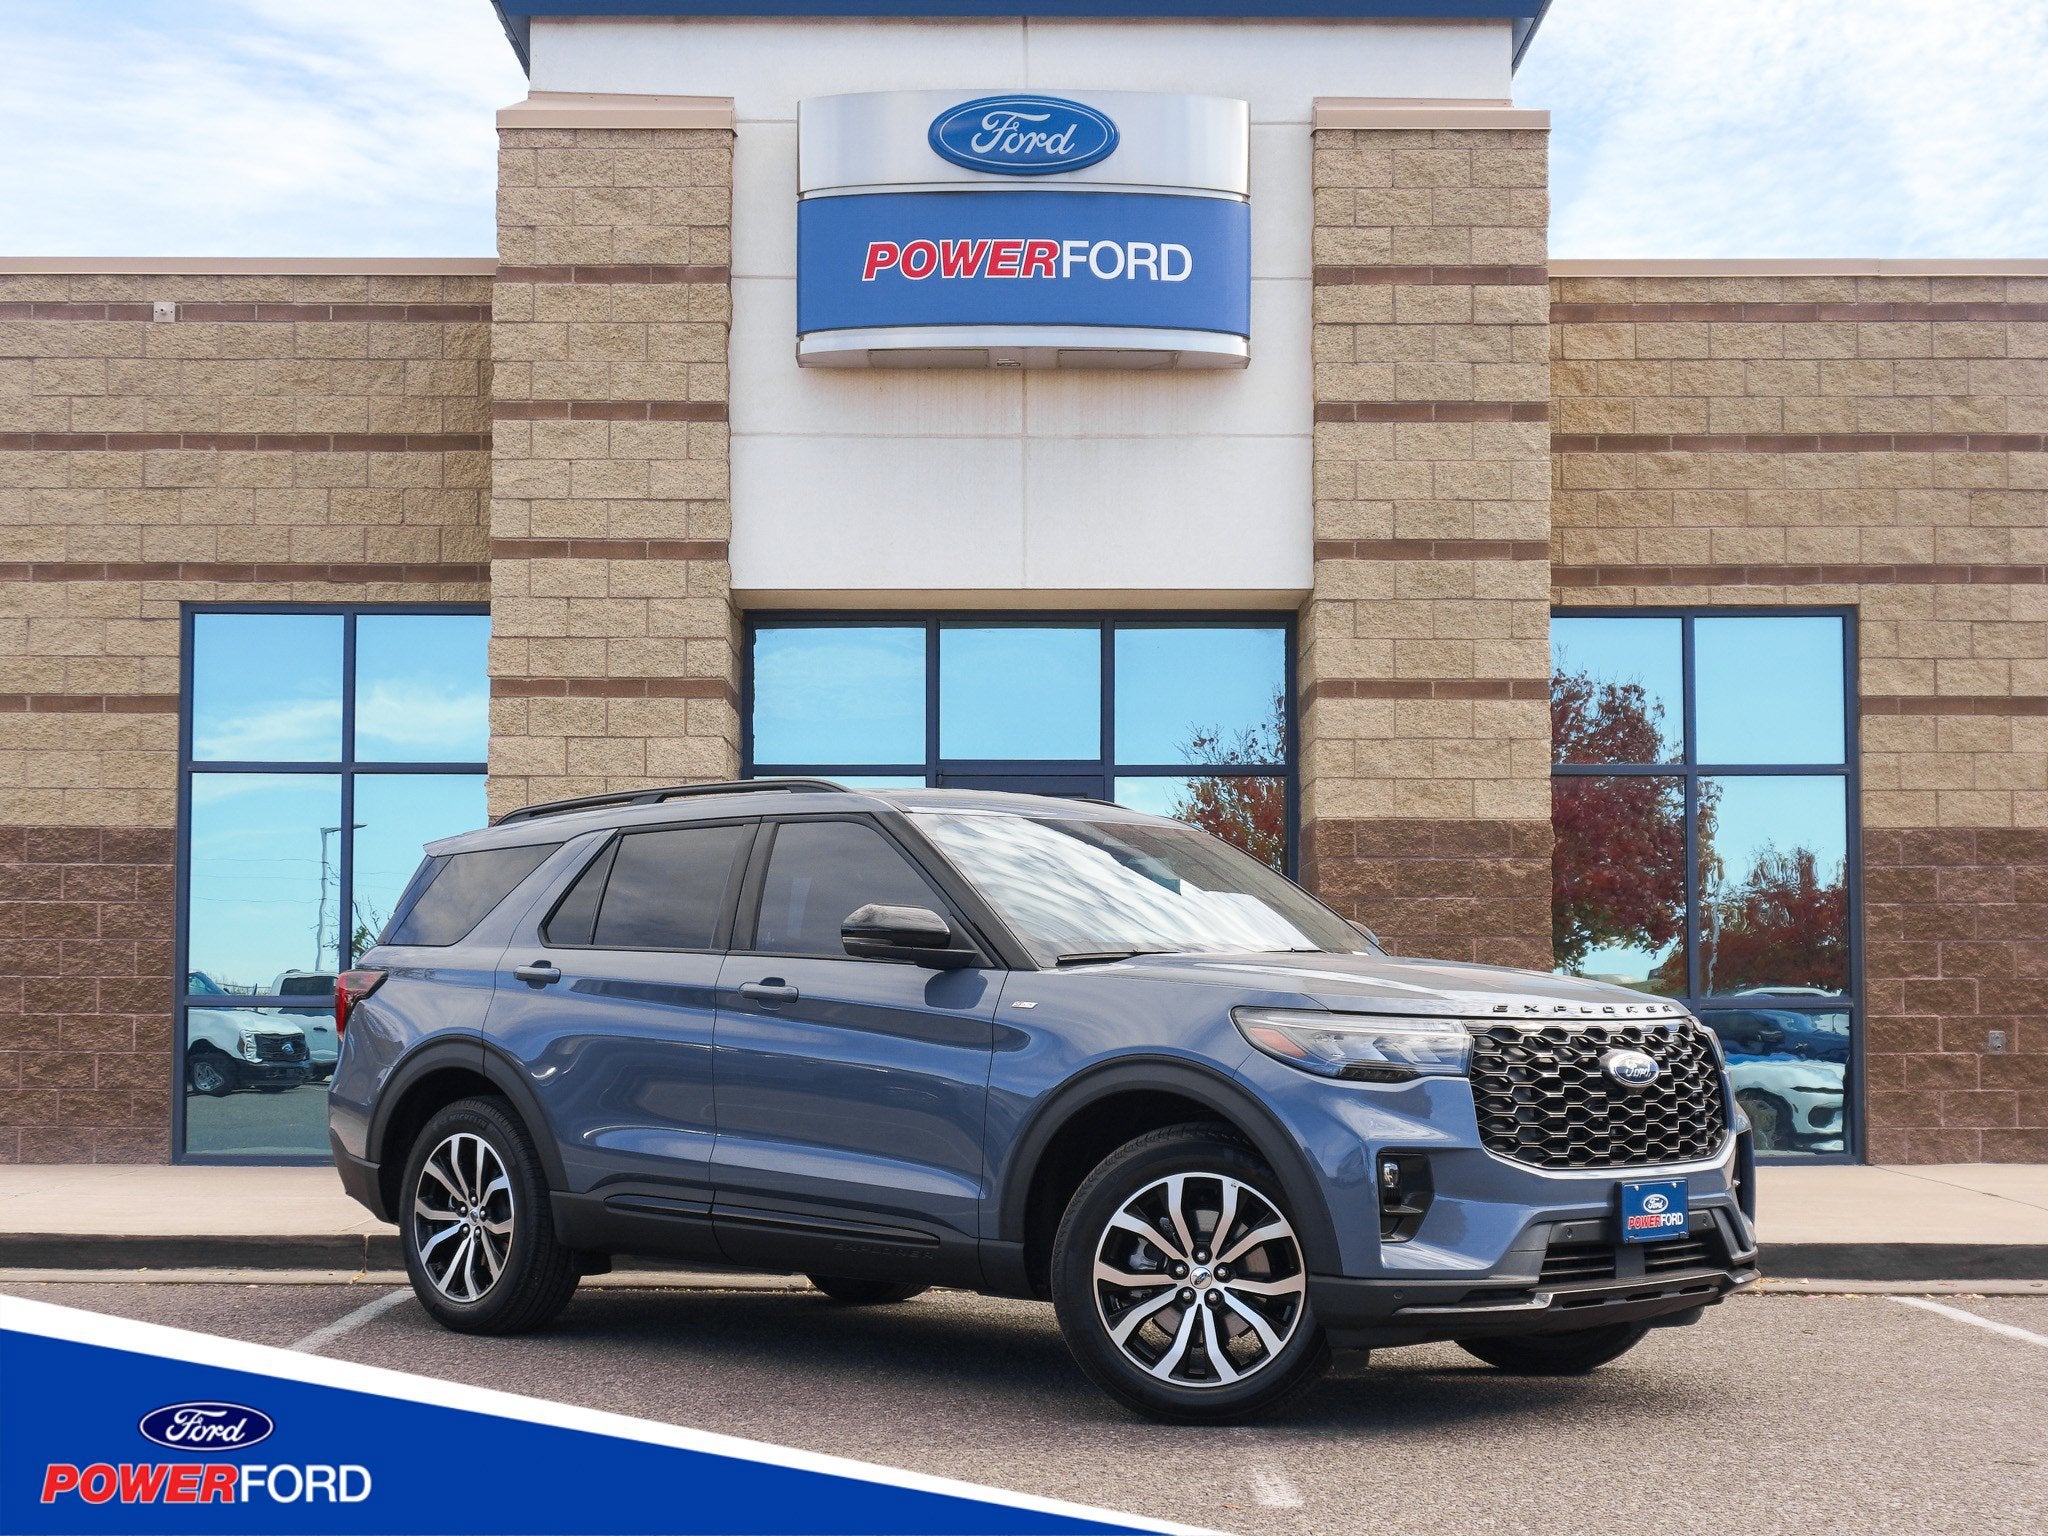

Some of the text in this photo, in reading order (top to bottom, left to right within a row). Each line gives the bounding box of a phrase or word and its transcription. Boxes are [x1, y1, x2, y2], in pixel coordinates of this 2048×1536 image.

[970, 110, 1078, 156] Ford
[862, 238, 1193, 282] POWERFORD
[1492, 1004, 1673, 1014] EXPLORER
[1624, 1058, 1652, 1078] Ford
[1627, 1212, 1684, 1230] POWERFORD
